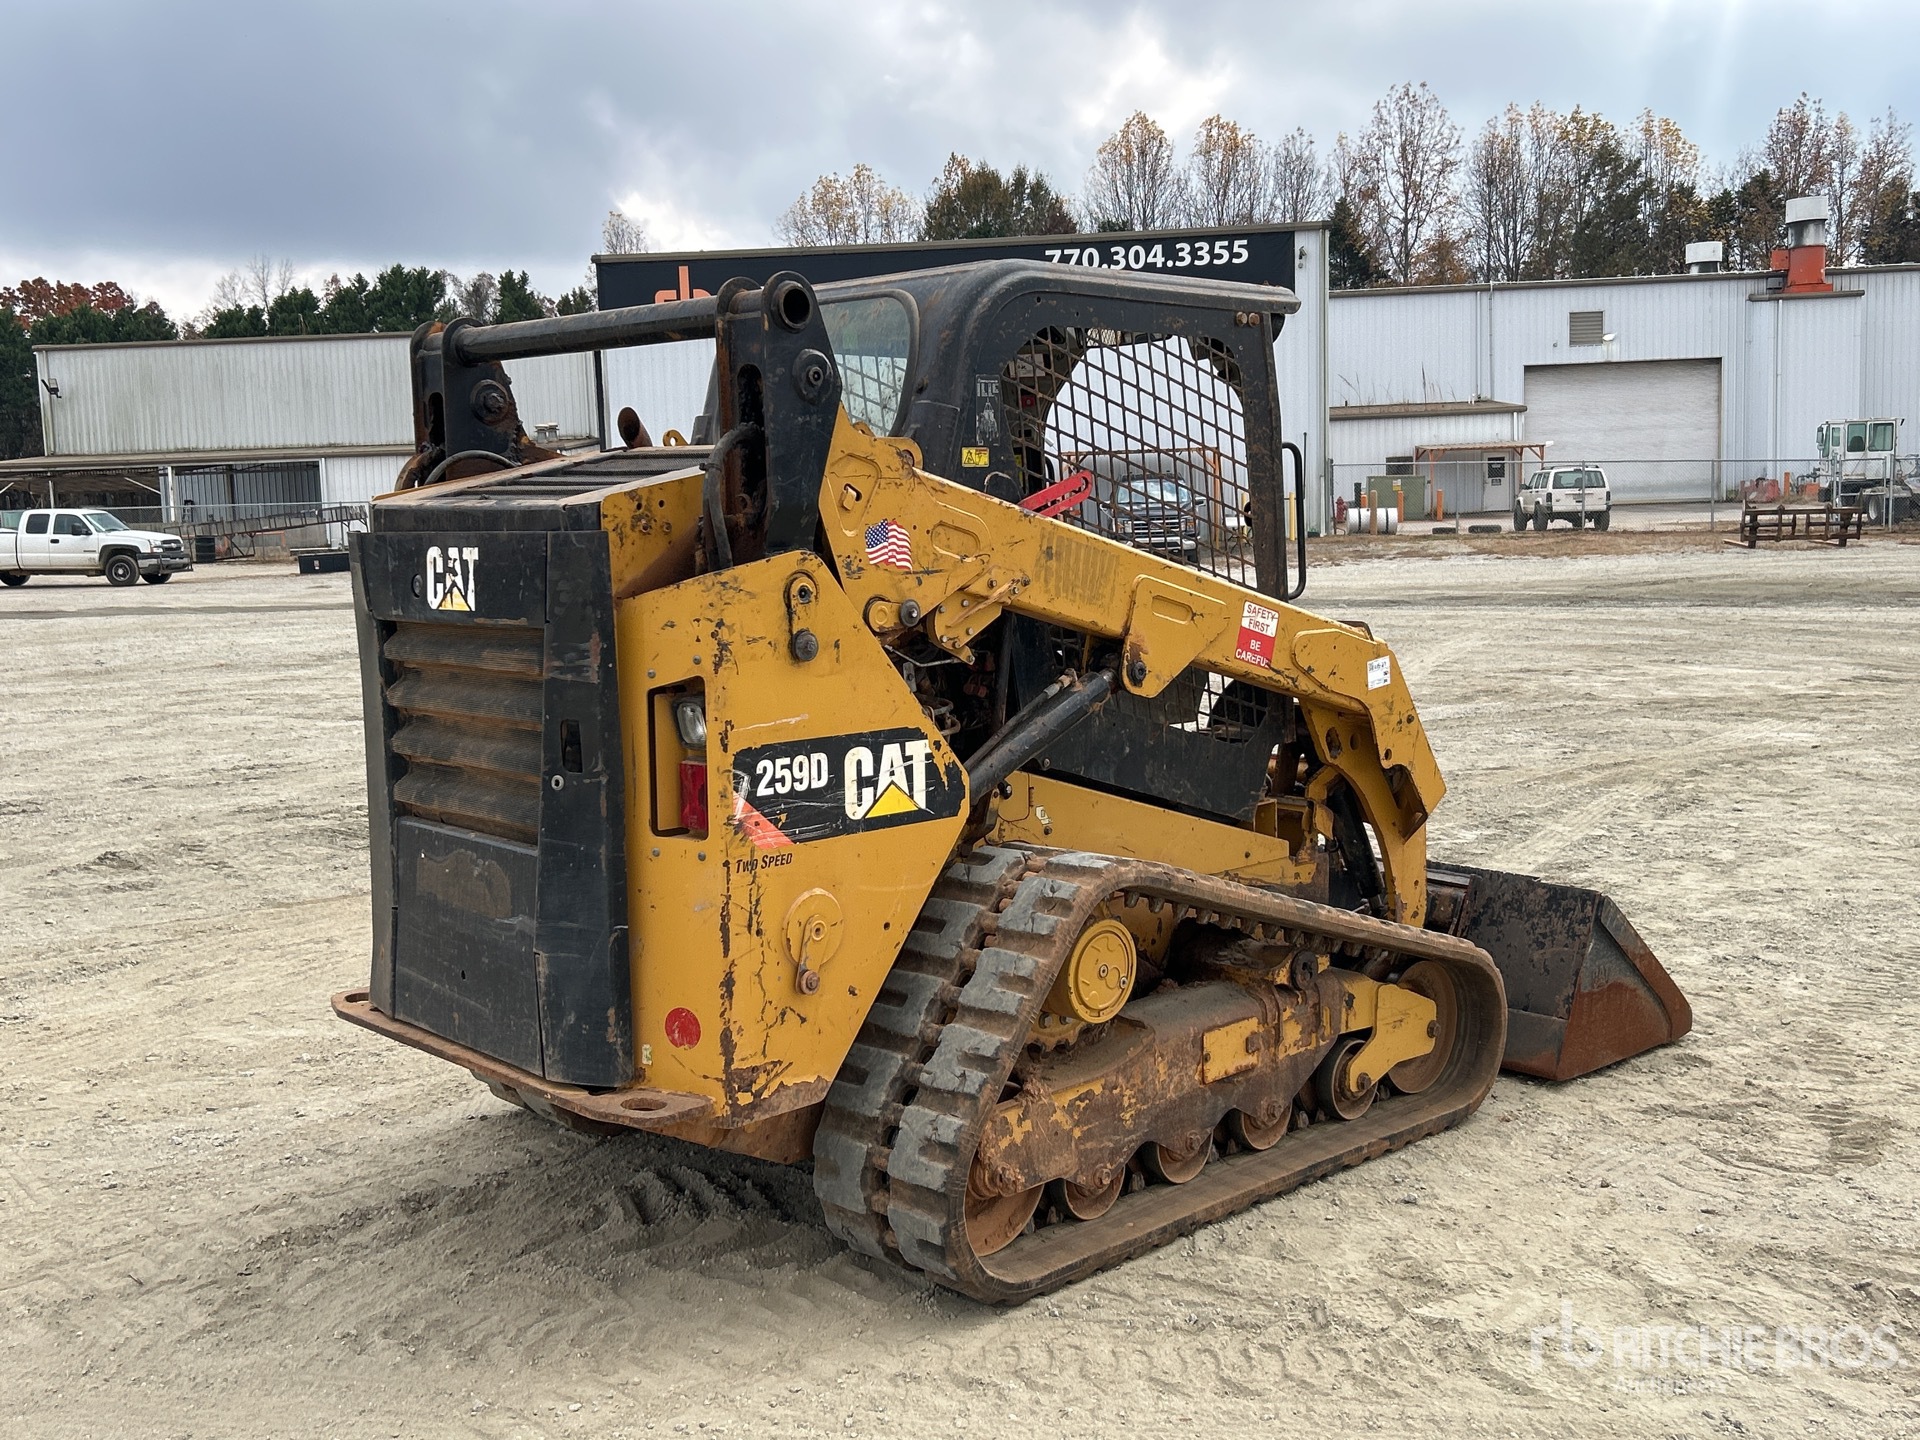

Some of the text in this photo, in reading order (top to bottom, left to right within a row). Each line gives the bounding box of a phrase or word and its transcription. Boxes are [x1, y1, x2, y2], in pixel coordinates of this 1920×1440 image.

[1045, 240, 1249, 270] 770.304.3355
[426, 546, 479, 611] CAT
[1246, 604, 1277, 622] SAFETY
[1248, 618, 1270, 633] FIRST
[1249, 639, 1262, 652] BE
[755, 739, 932, 821] 259D CAT
